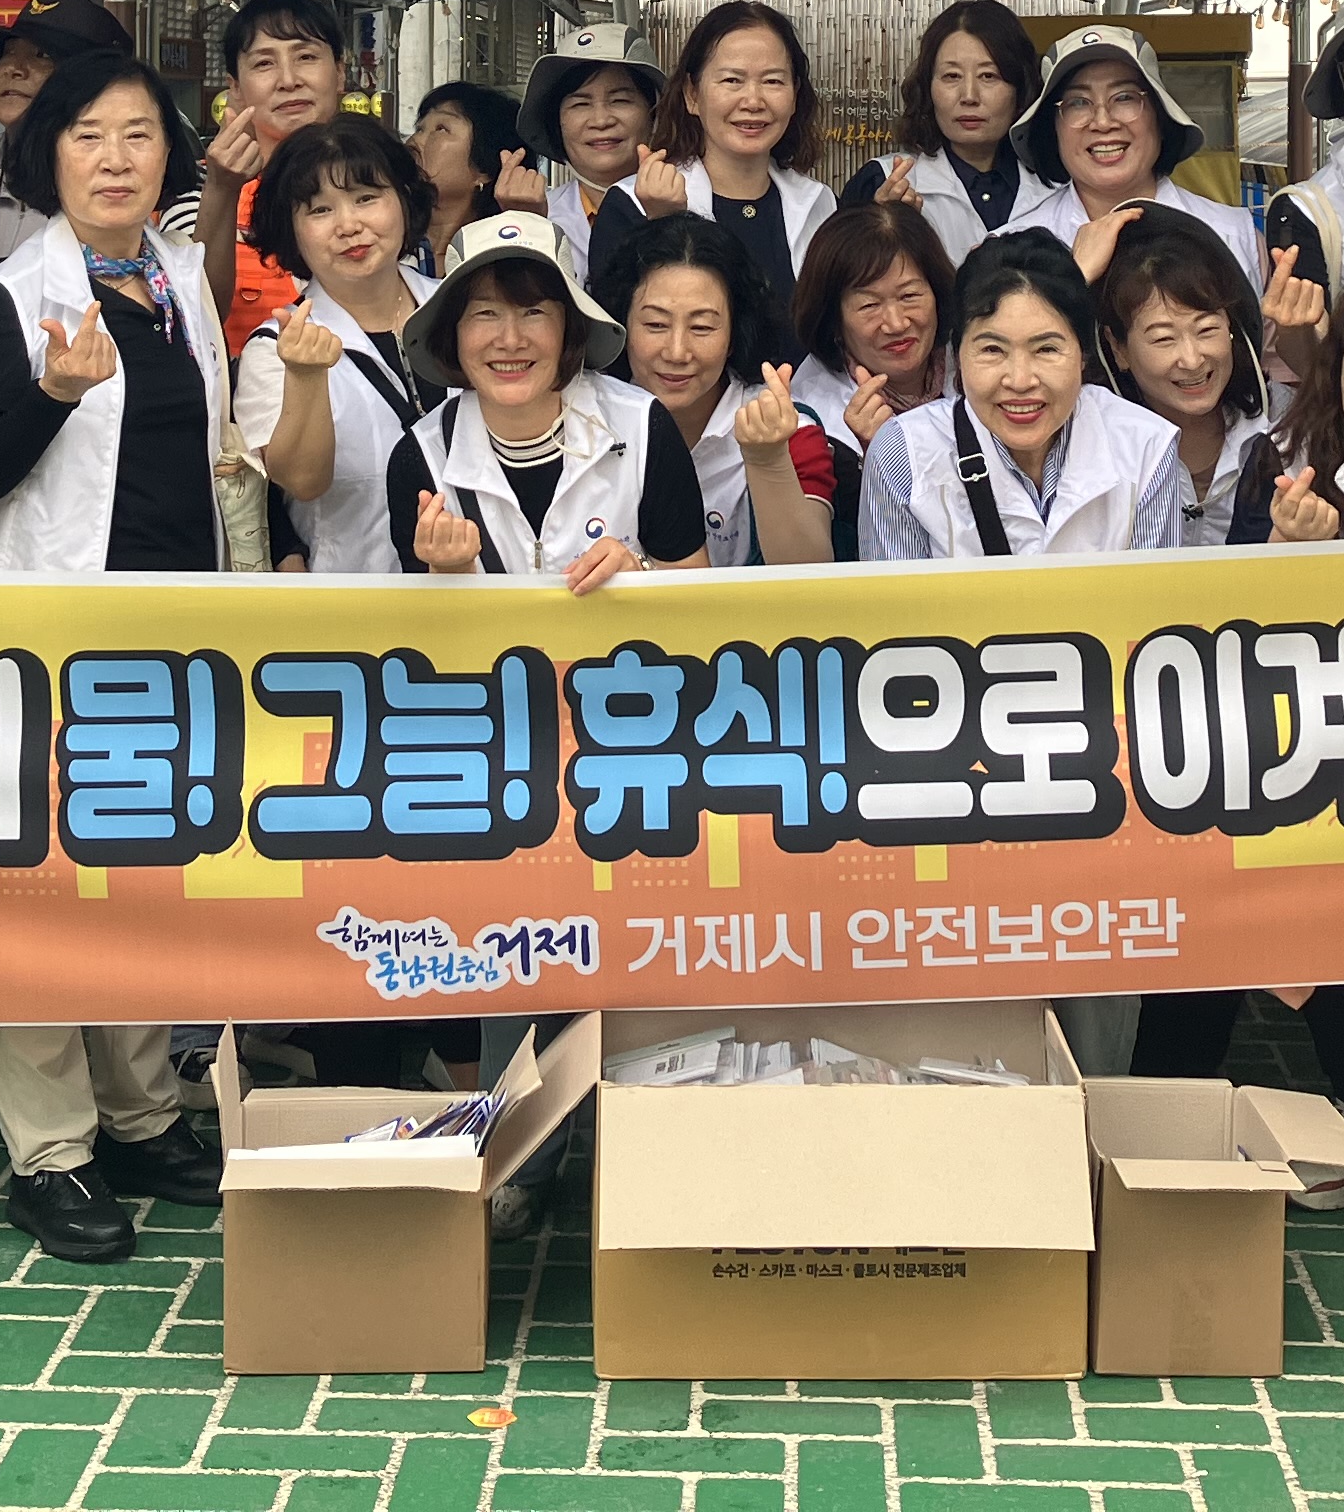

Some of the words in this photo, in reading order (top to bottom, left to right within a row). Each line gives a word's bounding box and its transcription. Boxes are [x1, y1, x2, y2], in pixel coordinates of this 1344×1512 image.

[62, 654, 219, 842] 물!
[255, 652, 536, 838] 그늘!
[482, 924, 591, 976] 거제
[624, 910, 825, 978] 거제시
[846, 896, 1187, 970] 안전보안관
[711, 1262, 750, 1279] 손수건
[758, 1262, 797, 1279] 스카프
[806, 1262, 844, 1279] 마스크
[892, 1262, 967, 1279] 전문제조업체
